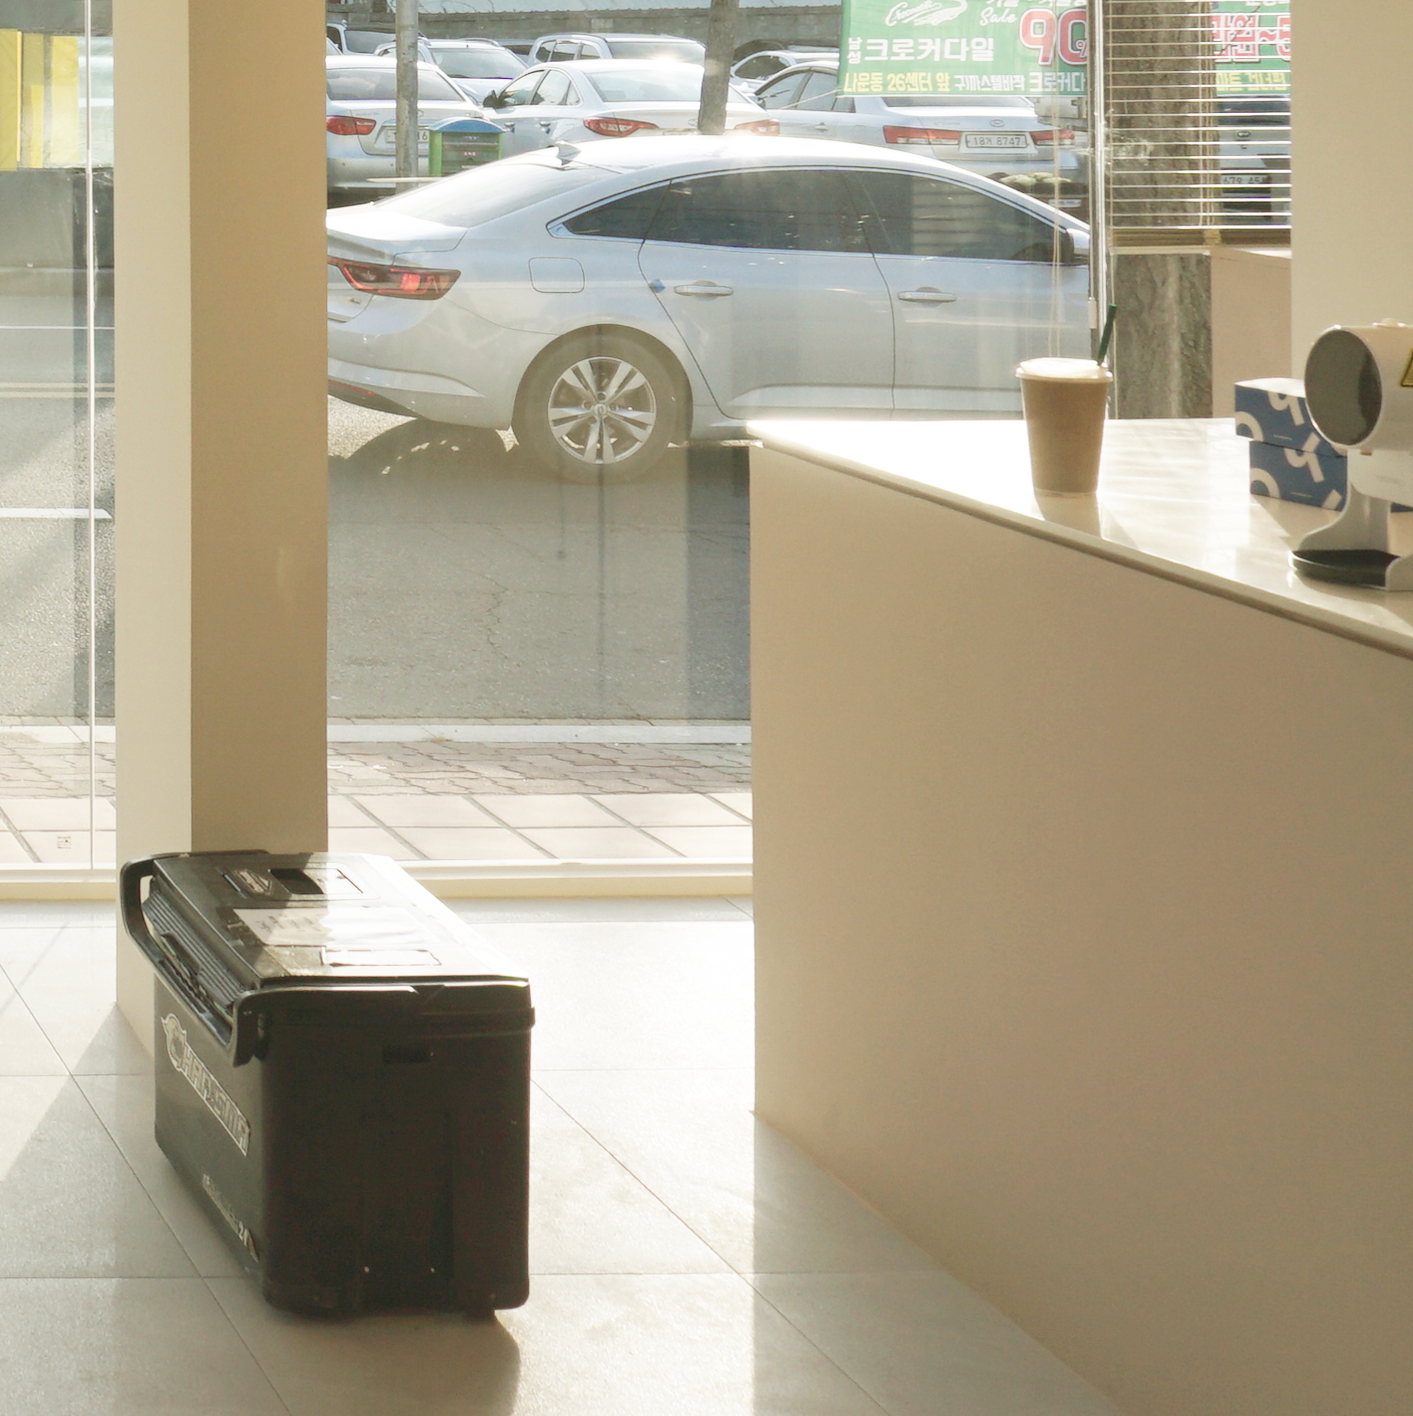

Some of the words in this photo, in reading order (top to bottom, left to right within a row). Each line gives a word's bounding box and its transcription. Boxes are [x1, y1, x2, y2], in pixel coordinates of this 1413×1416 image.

[980, 7, 1018, 26] Sale
[864, 37, 995, 62] 크로커다일
[936, 72, 950, 92] 앞
